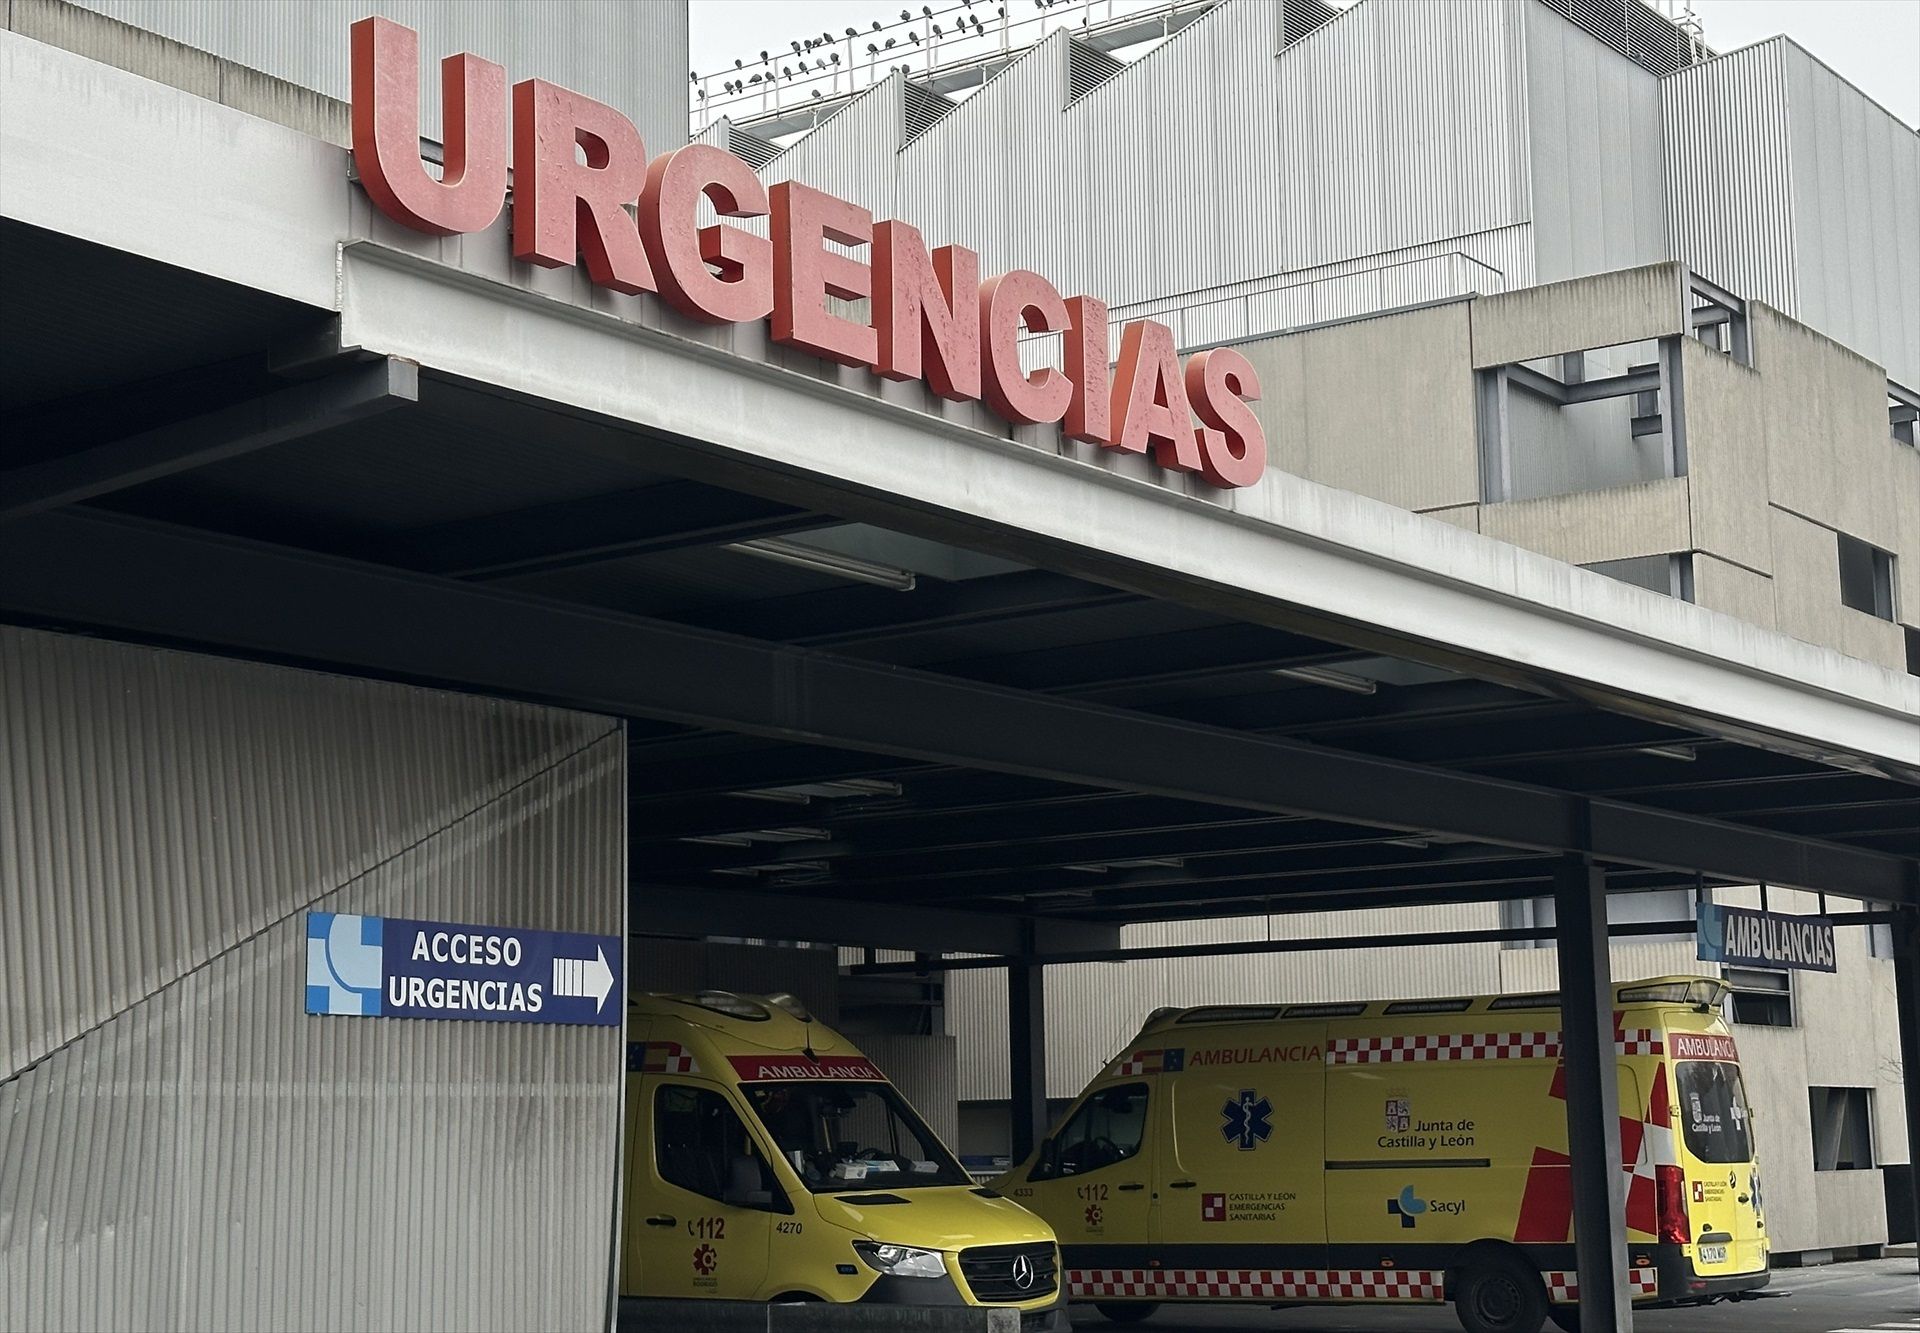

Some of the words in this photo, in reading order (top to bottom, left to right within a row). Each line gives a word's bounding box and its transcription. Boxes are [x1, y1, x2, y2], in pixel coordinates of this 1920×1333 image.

[350, 15, 1267, 489] URGENCIAS
[1725, 914, 1834, 967] AMBULANCIAS
[411, 931, 522, 967] ACCESO
[388, 975, 544, 1013] URGENCIAS
[1188, 1045, 1322, 1066] AMBULANCIA
[758, 1065, 880, 1079] AMBULANCIA
[1414, 1120, 1453, 1132] Junta
[1457, 1119, 1474, 1131] de
[1377, 1136, 1425, 1148] Castilla
[1429, 1138, 1437, 1150] y
[1440, 1134, 1475, 1147] León
[1013, 1188, 1033, 1197] 4333
[1084, 1184, 1108, 1200] 112
[1229, 1193, 1266, 1201] CASTILLA
[1266, 1193, 1273, 1201] Y
[1229, 1203, 1286, 1211] EMERGENCIAS
[1430, 1199, 1465, 1215] Sacyl
[1229, 1213, 1277, 1221] SANITARIAS
[696, 1217, 725, 1240] 112
[776, 1222, 803, 1234] 4270
